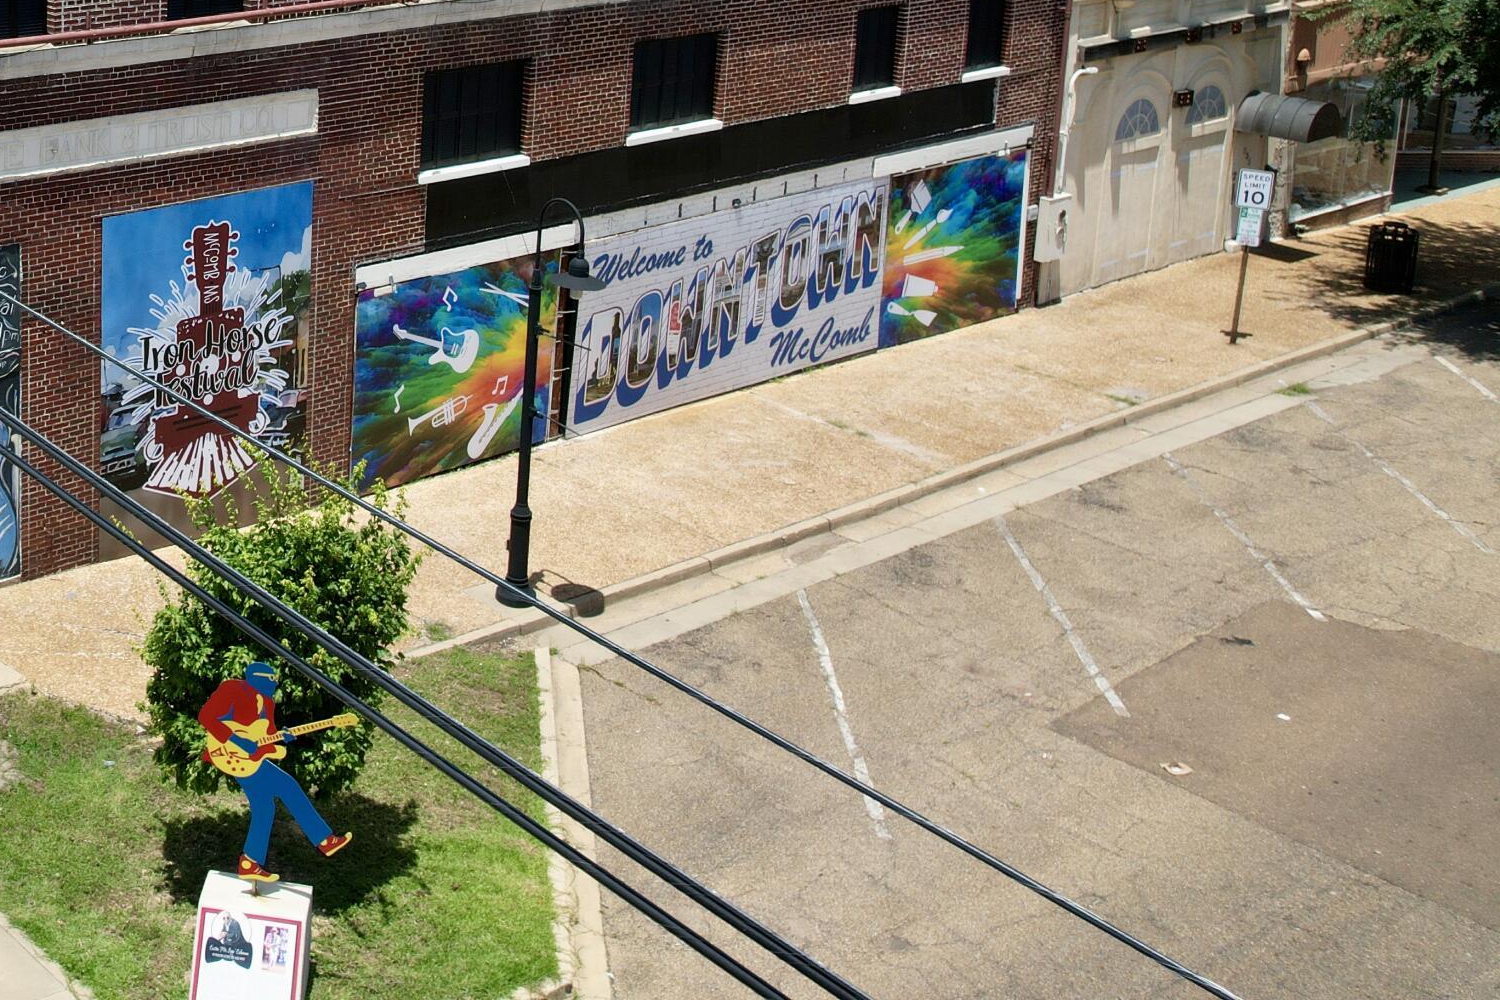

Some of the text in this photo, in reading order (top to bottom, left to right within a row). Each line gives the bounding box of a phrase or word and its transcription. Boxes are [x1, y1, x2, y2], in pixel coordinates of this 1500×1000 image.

[1243, 173, 1271, 183] SPEED
[1243, 190, 1265, 205] 10
[1244, 182, 1266, 190] LIMIT
[592, 234, 714, 286] Welcome to
[574, 185, 886, 424] DOWNTOWN
[139, 317, 281, 372] Iron Horse
[769, 305, 875, 367] McComb
[150, 351, 258, 408] Festival
